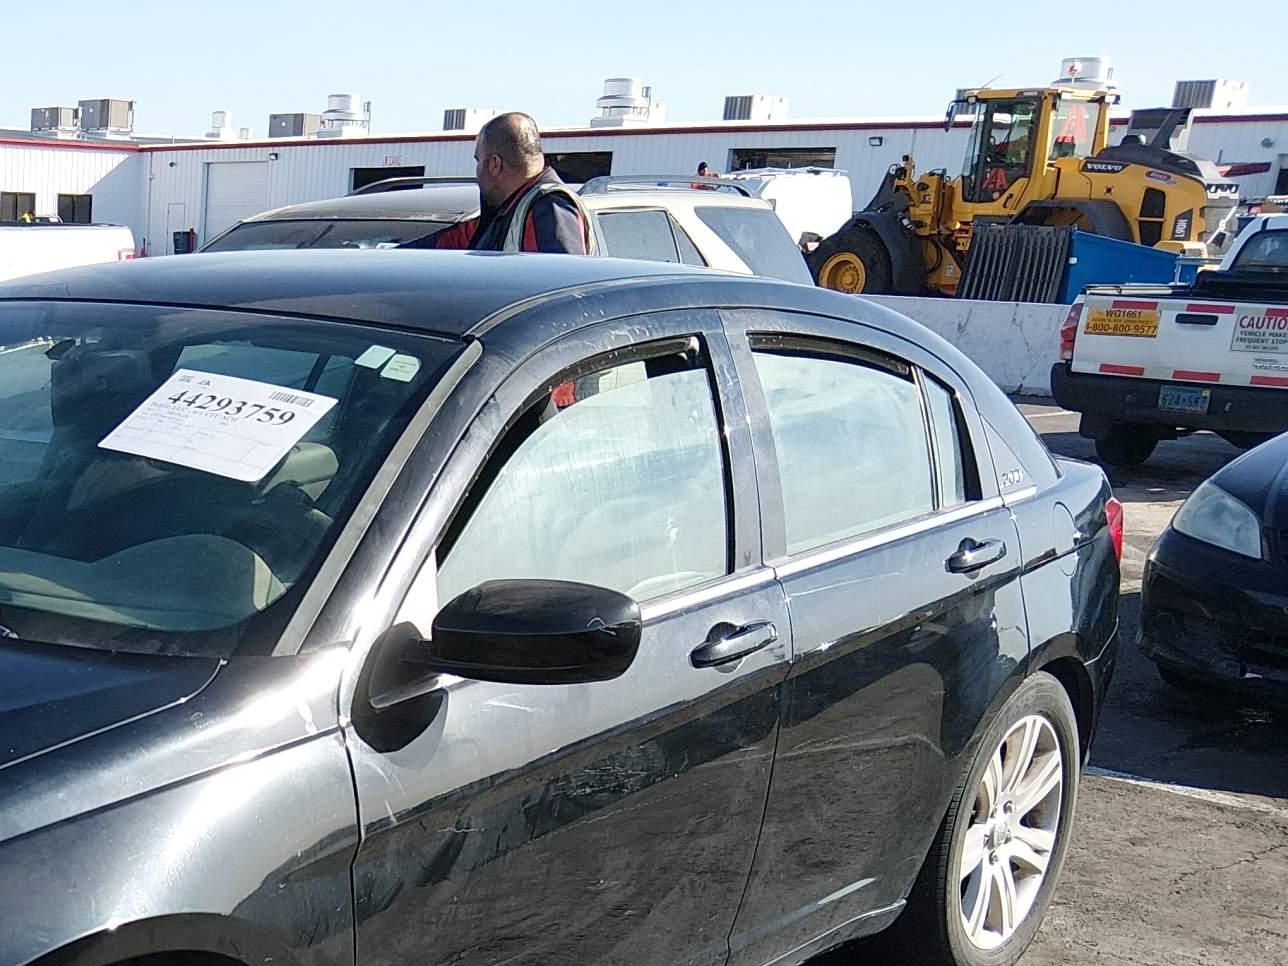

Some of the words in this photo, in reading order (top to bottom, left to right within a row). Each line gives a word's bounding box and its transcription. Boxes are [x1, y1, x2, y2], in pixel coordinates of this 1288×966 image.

[1087, 163, 1122, 171] VOLVO
[1174, 219, 1188, 238] L90H
[1105, 309, 1142, 319] WG1661
[1239, 315, 1288, 330] CAUTIO
[167, 390, 296, 426] 44293759
